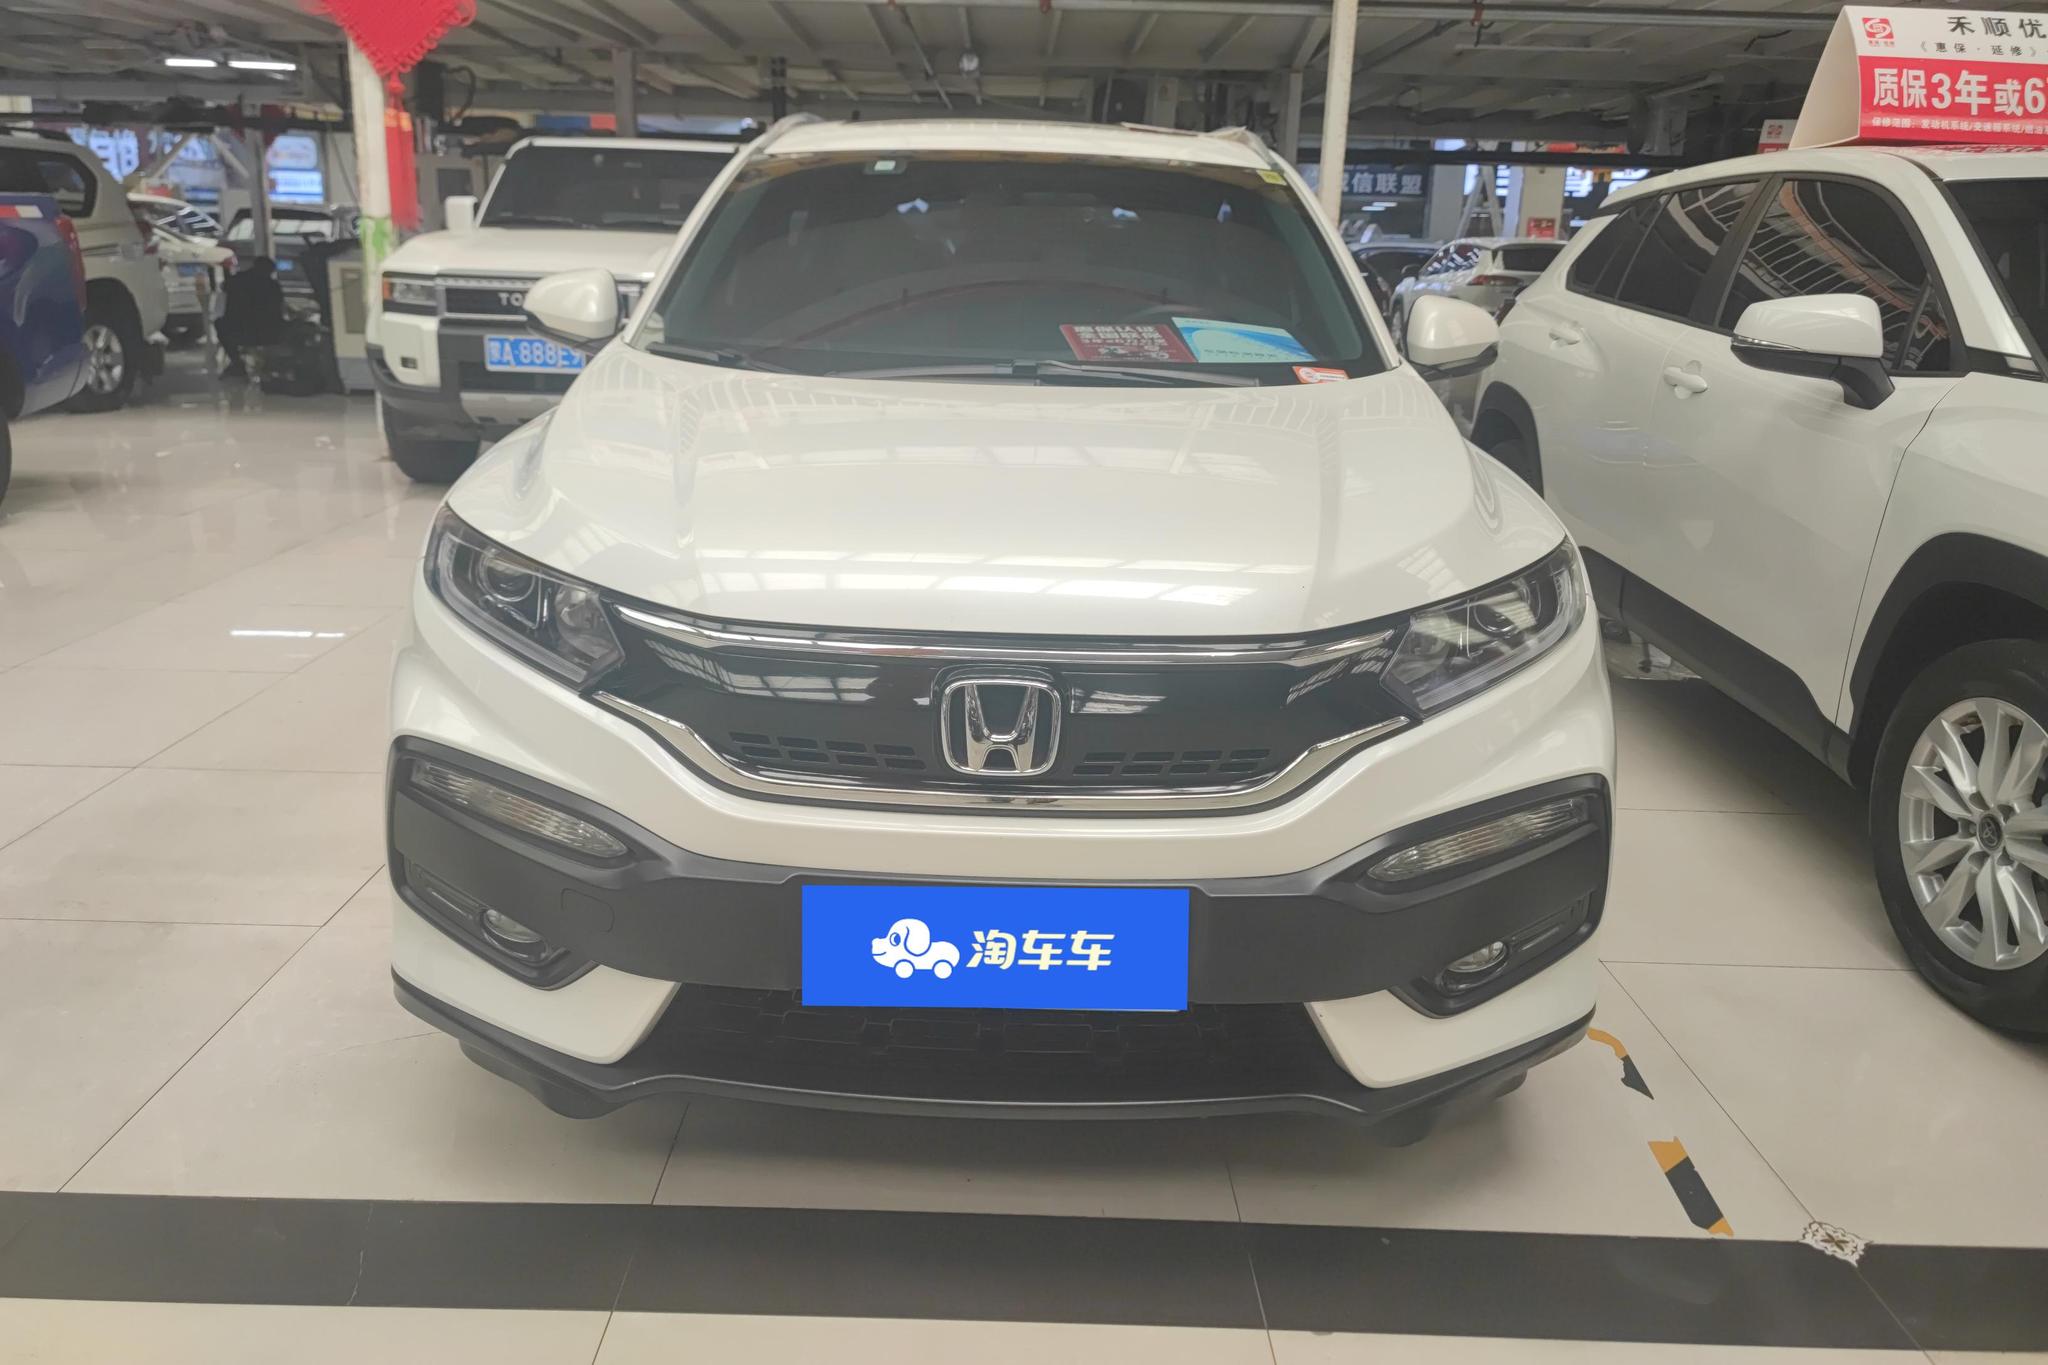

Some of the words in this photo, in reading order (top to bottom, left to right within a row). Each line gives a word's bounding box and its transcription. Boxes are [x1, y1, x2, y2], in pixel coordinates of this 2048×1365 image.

[1947, 16, 2048, 38] 禾顺优
[1872, 67, 2048, 117] 质保3年或6
[498, 291, 529, 307] TO
